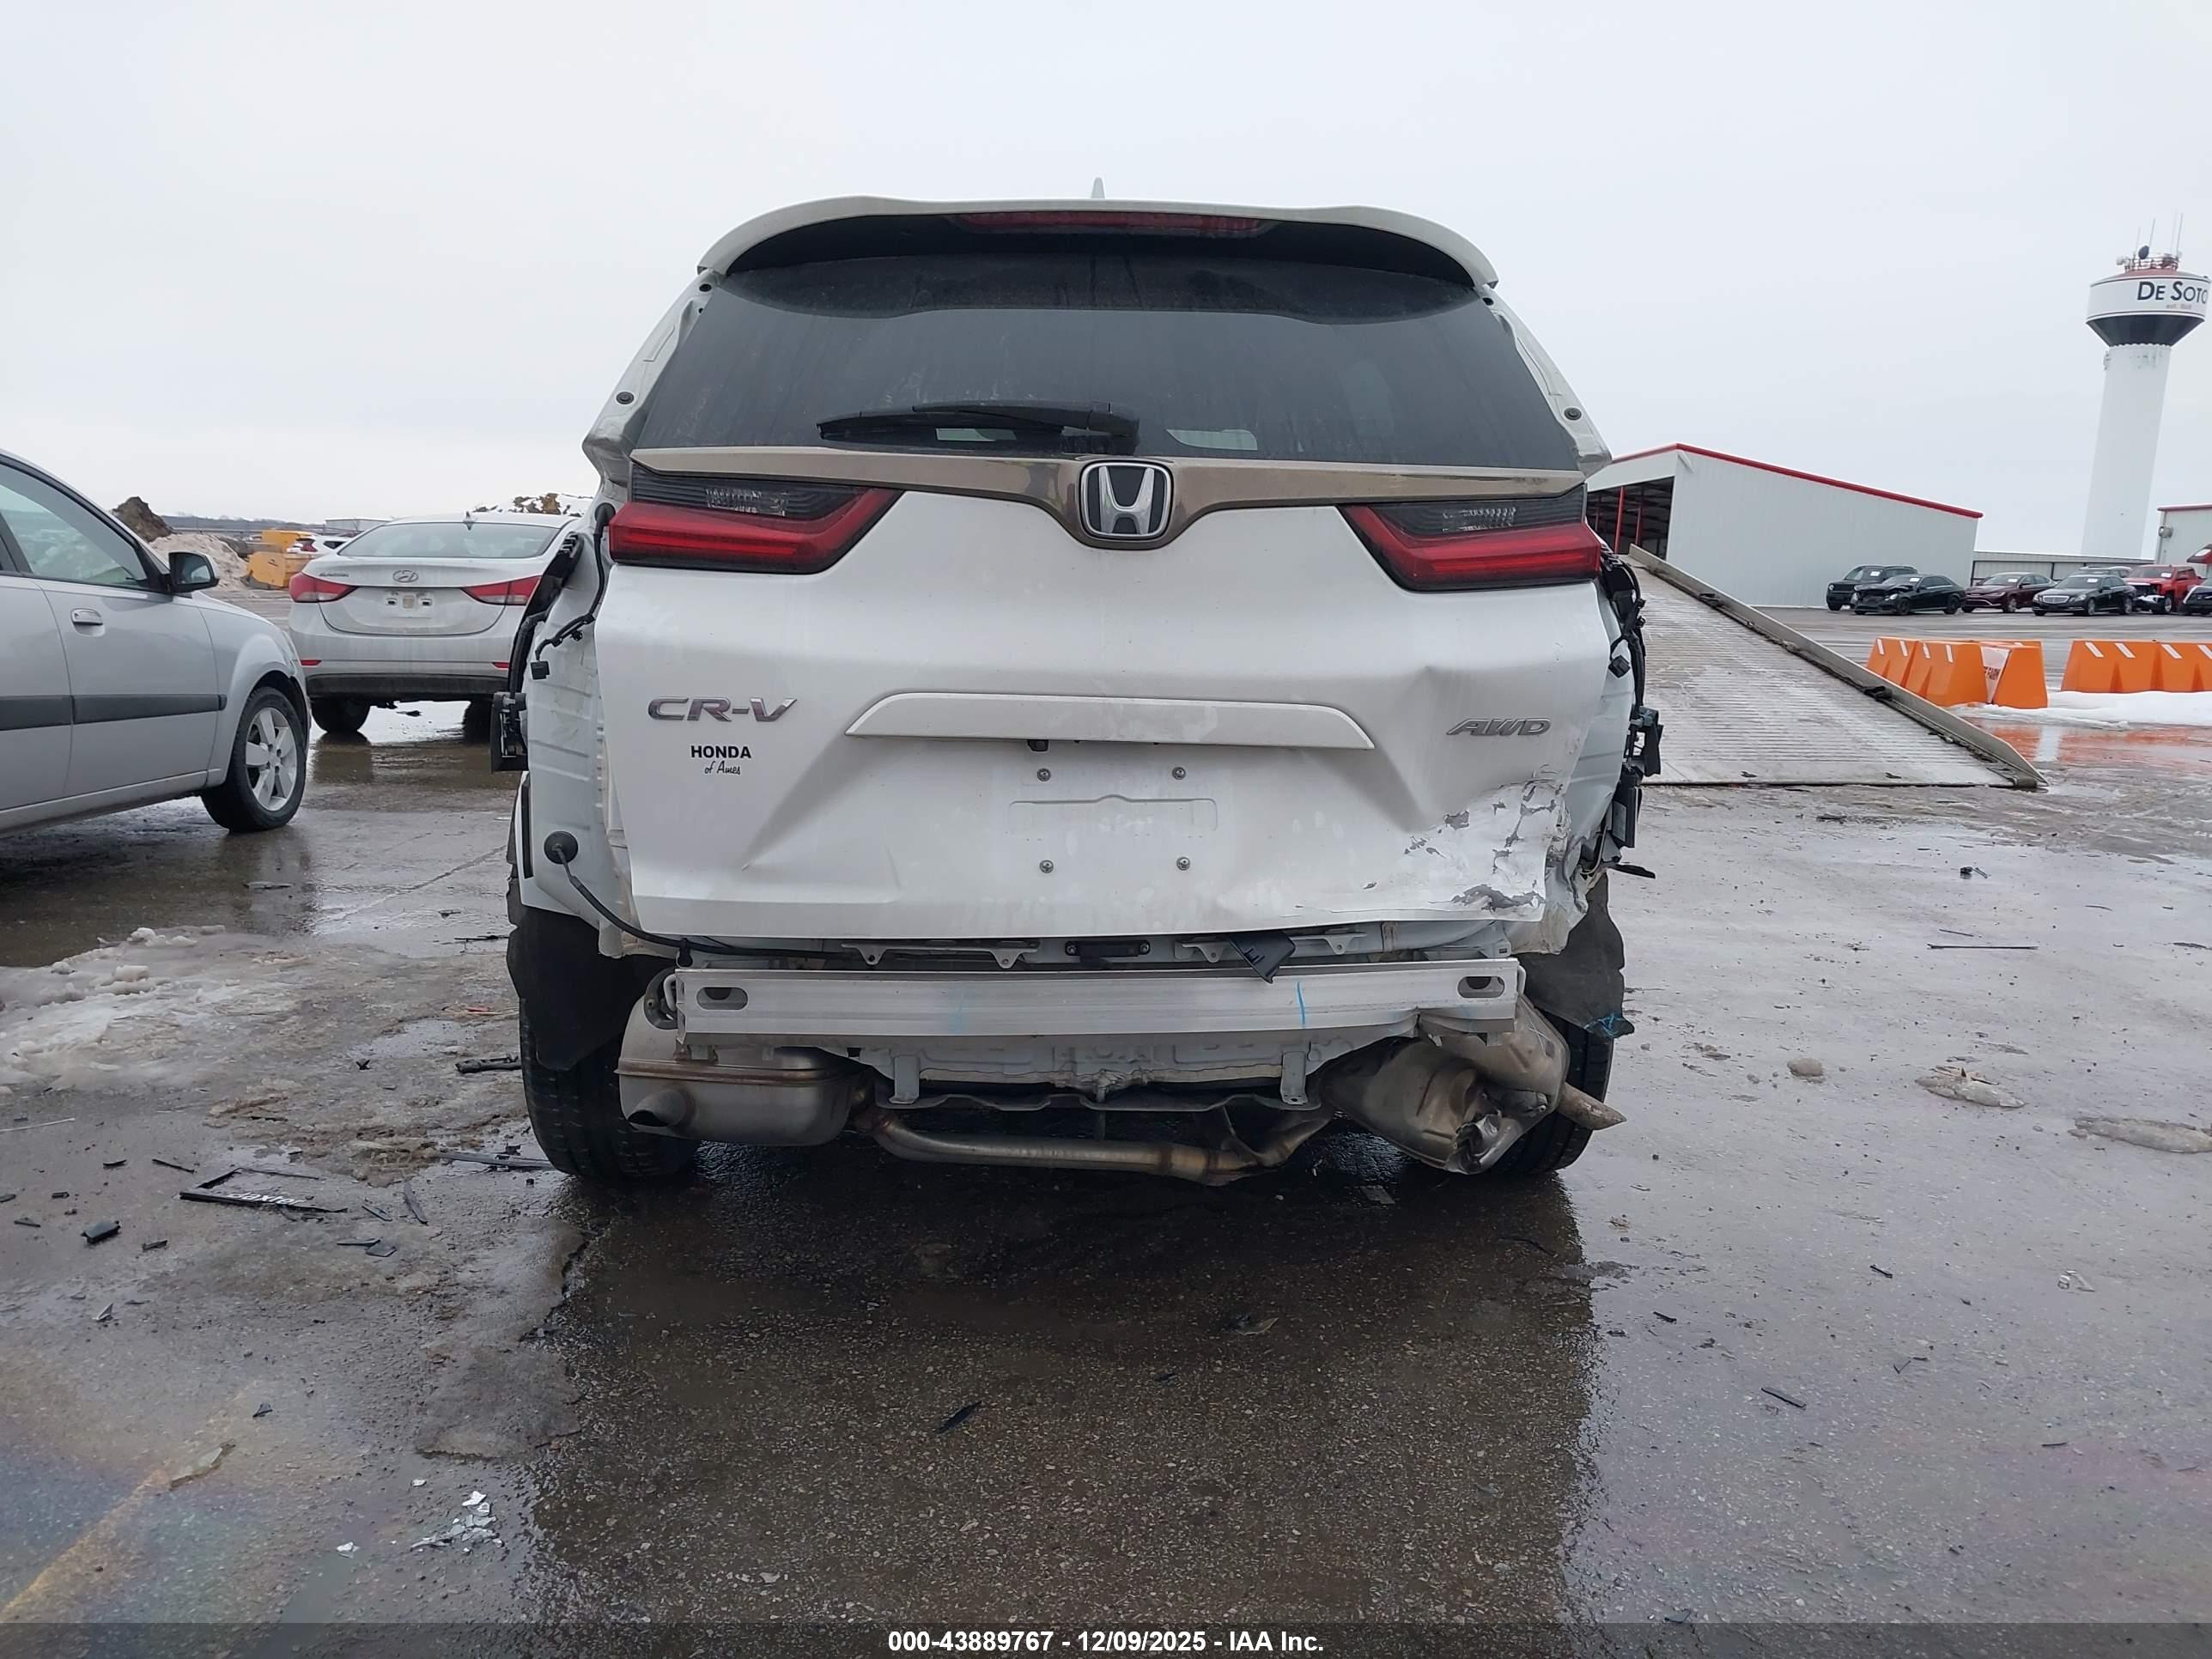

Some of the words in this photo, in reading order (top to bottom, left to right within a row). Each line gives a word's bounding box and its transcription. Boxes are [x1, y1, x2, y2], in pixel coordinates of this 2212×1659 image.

[2137, 281, 2166, 301] DE
[647, 696, 798, 722] CR-V
[1446, 718, 1552, 736] AWD
[690, 744, 752, 759] HONDA
[704, 760, 716, 775] of
